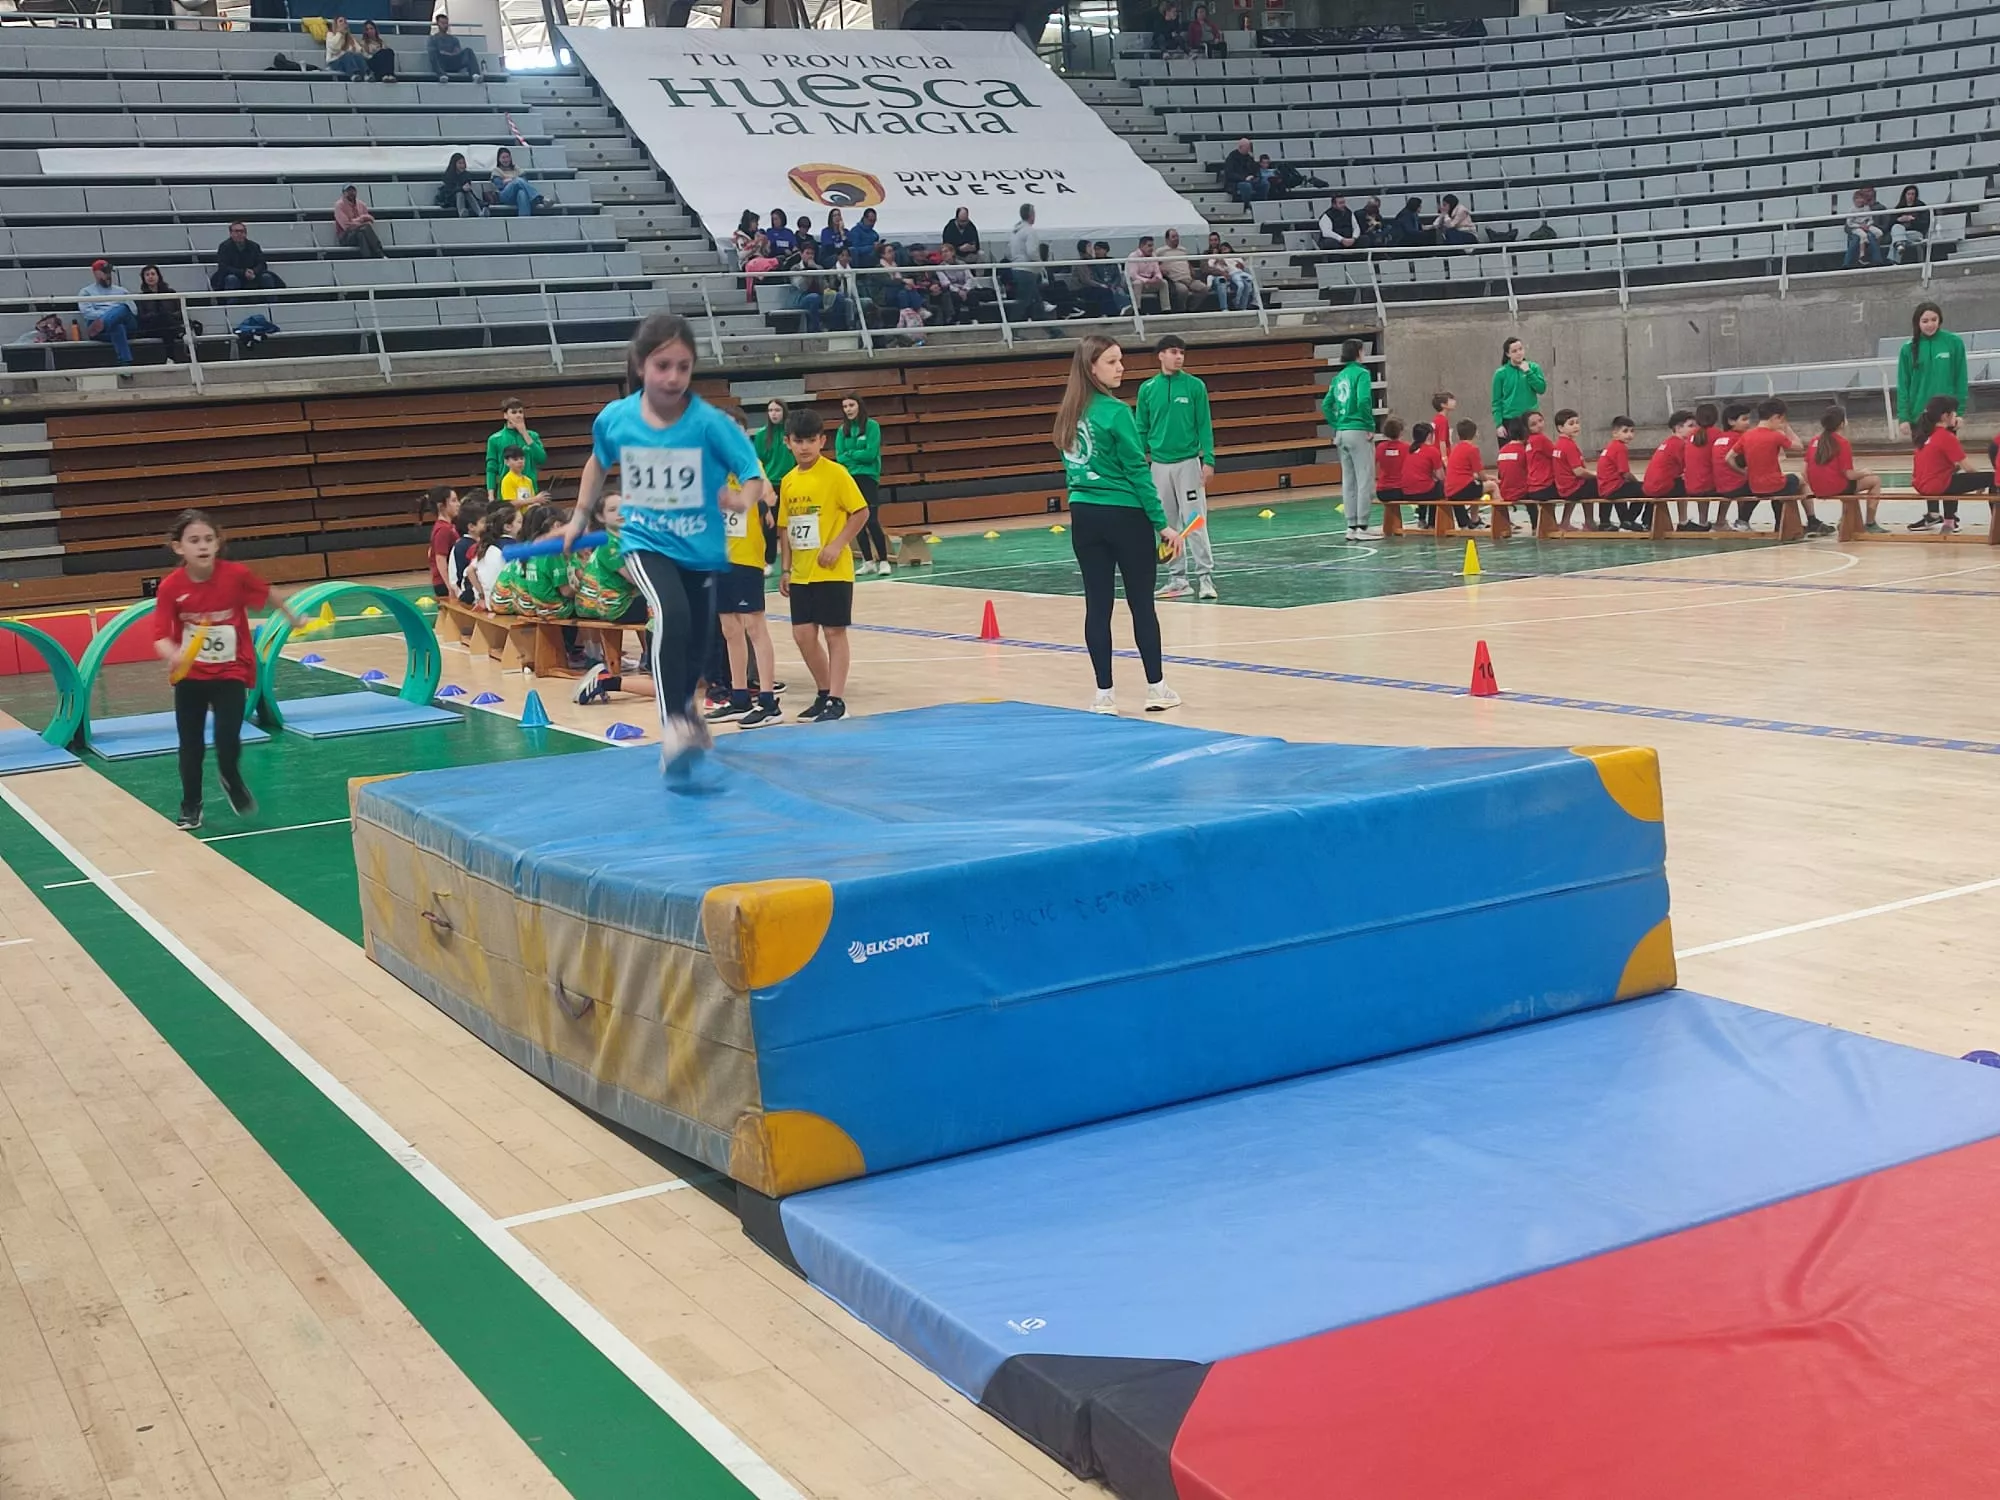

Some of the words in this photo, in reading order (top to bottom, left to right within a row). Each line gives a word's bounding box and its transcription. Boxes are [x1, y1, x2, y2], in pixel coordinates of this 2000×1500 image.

[894, 167, 1065, 183] DIPUTACIÓN
[904, 182, 1077, 197] HUESCA
[1720, 314, 1736, 337] 2
[628, 465, 695, 490] 3119
[790, 525, 811, 539] 427
[1478, 661, 1494, 679] 10
[865, 931, 931, 957] ELKSPORT
